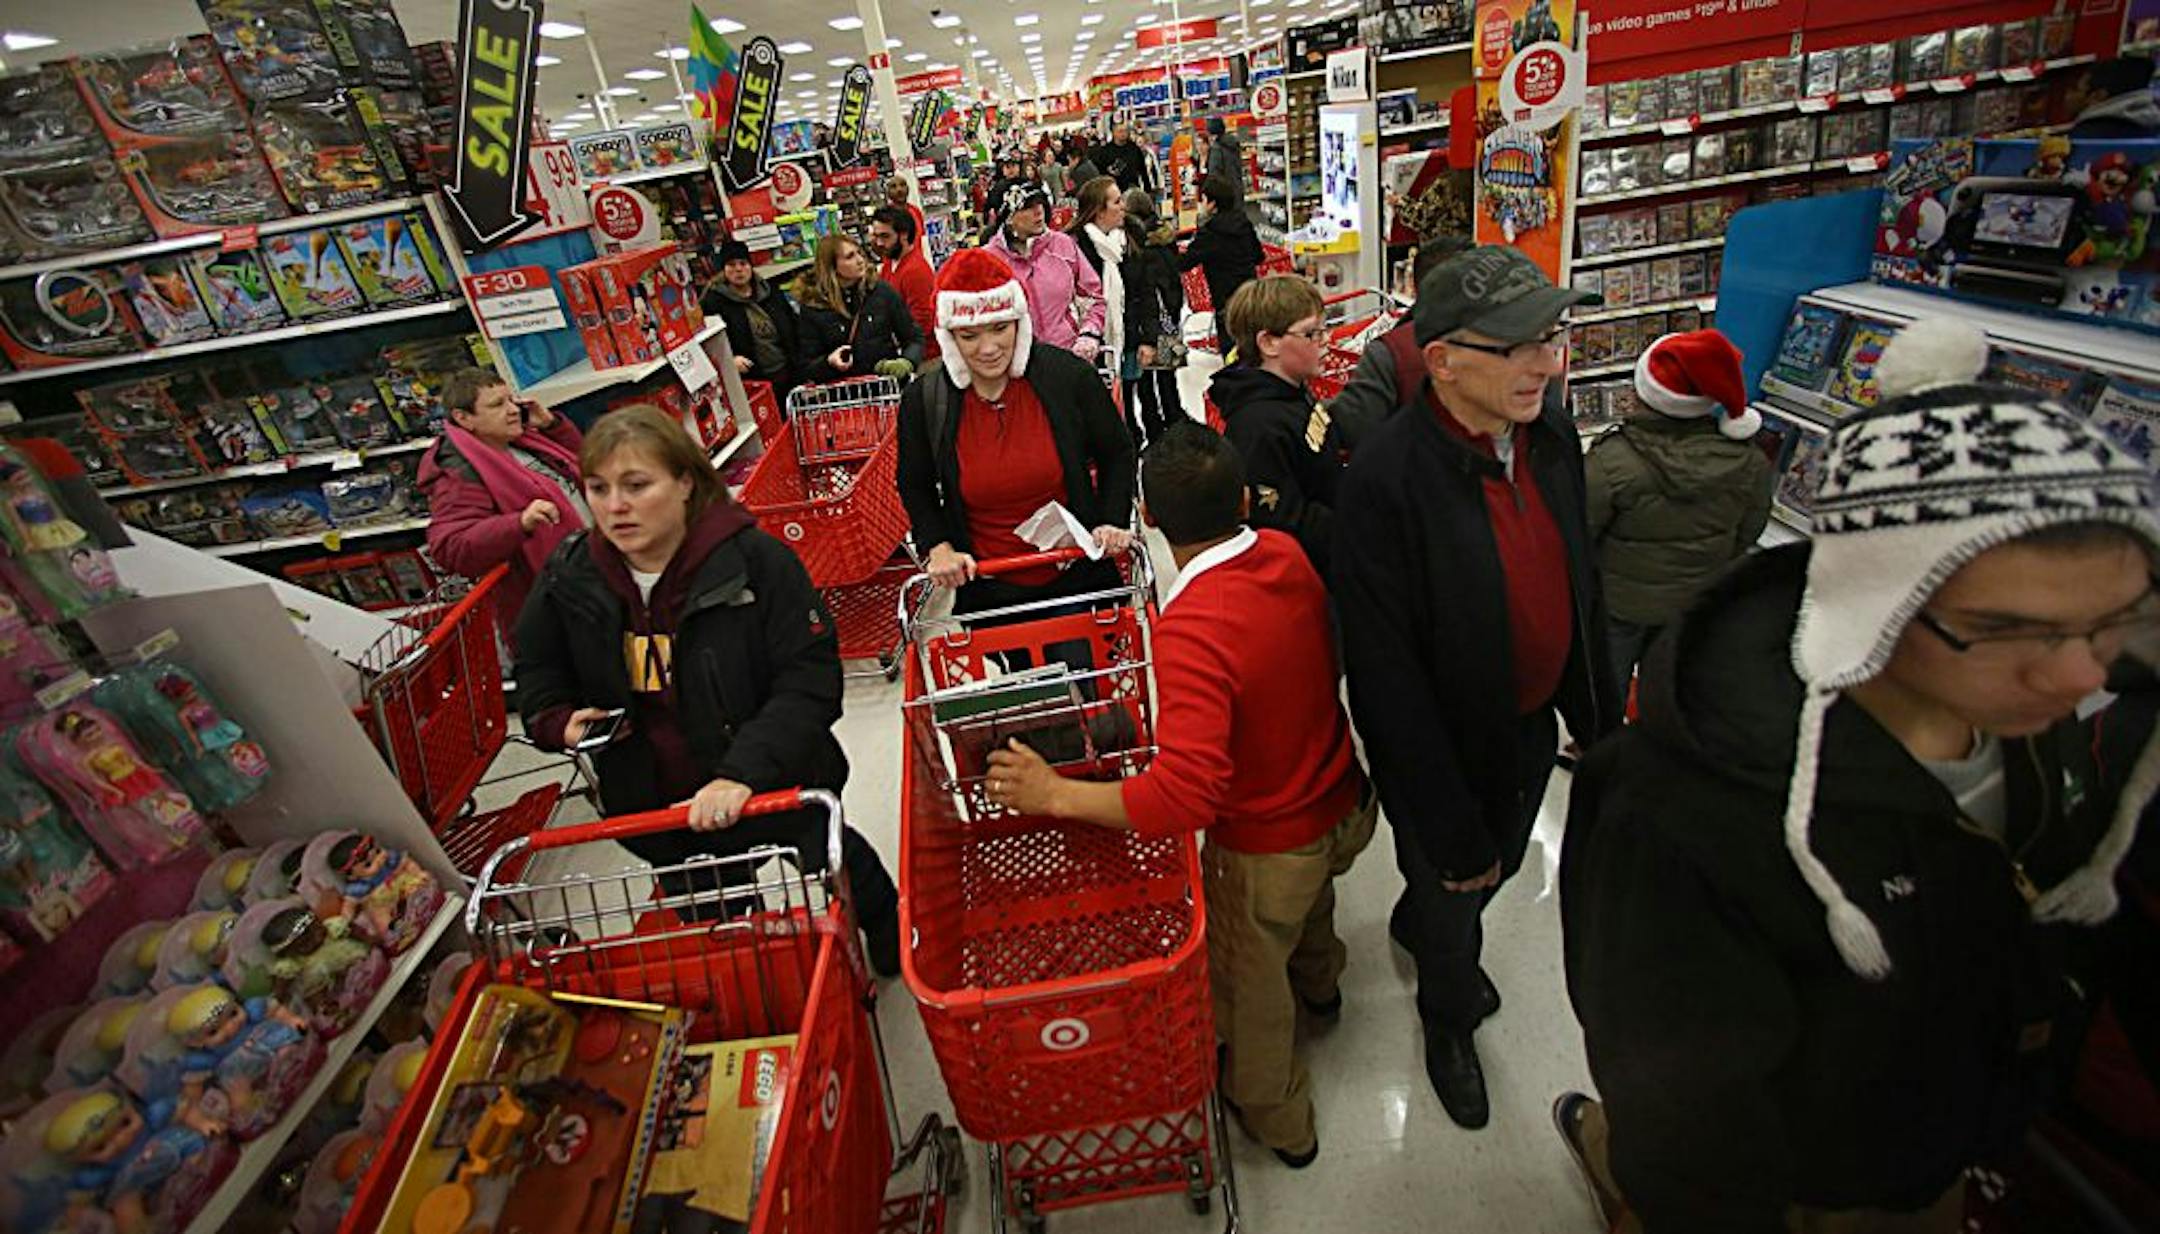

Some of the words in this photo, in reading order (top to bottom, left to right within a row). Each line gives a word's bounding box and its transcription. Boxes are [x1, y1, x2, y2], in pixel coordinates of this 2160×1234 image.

[1606, 17, 1643, 32] video
[1646, 9, 1691, 28] games
[1525, 56, 1557, 83] 5%
[468, 27, 519, 178] SALE
[736, 72, 770, 152] SALE
[841, 87, 864, 141] SALE
[641, 127, 686, 145] SORRY!
[602, 195, 632, 220] 5%
[473, 277, 489, 296] F
[491, 271, 527, 292] 30
[755, 1050, 777, 1103] LEGO
